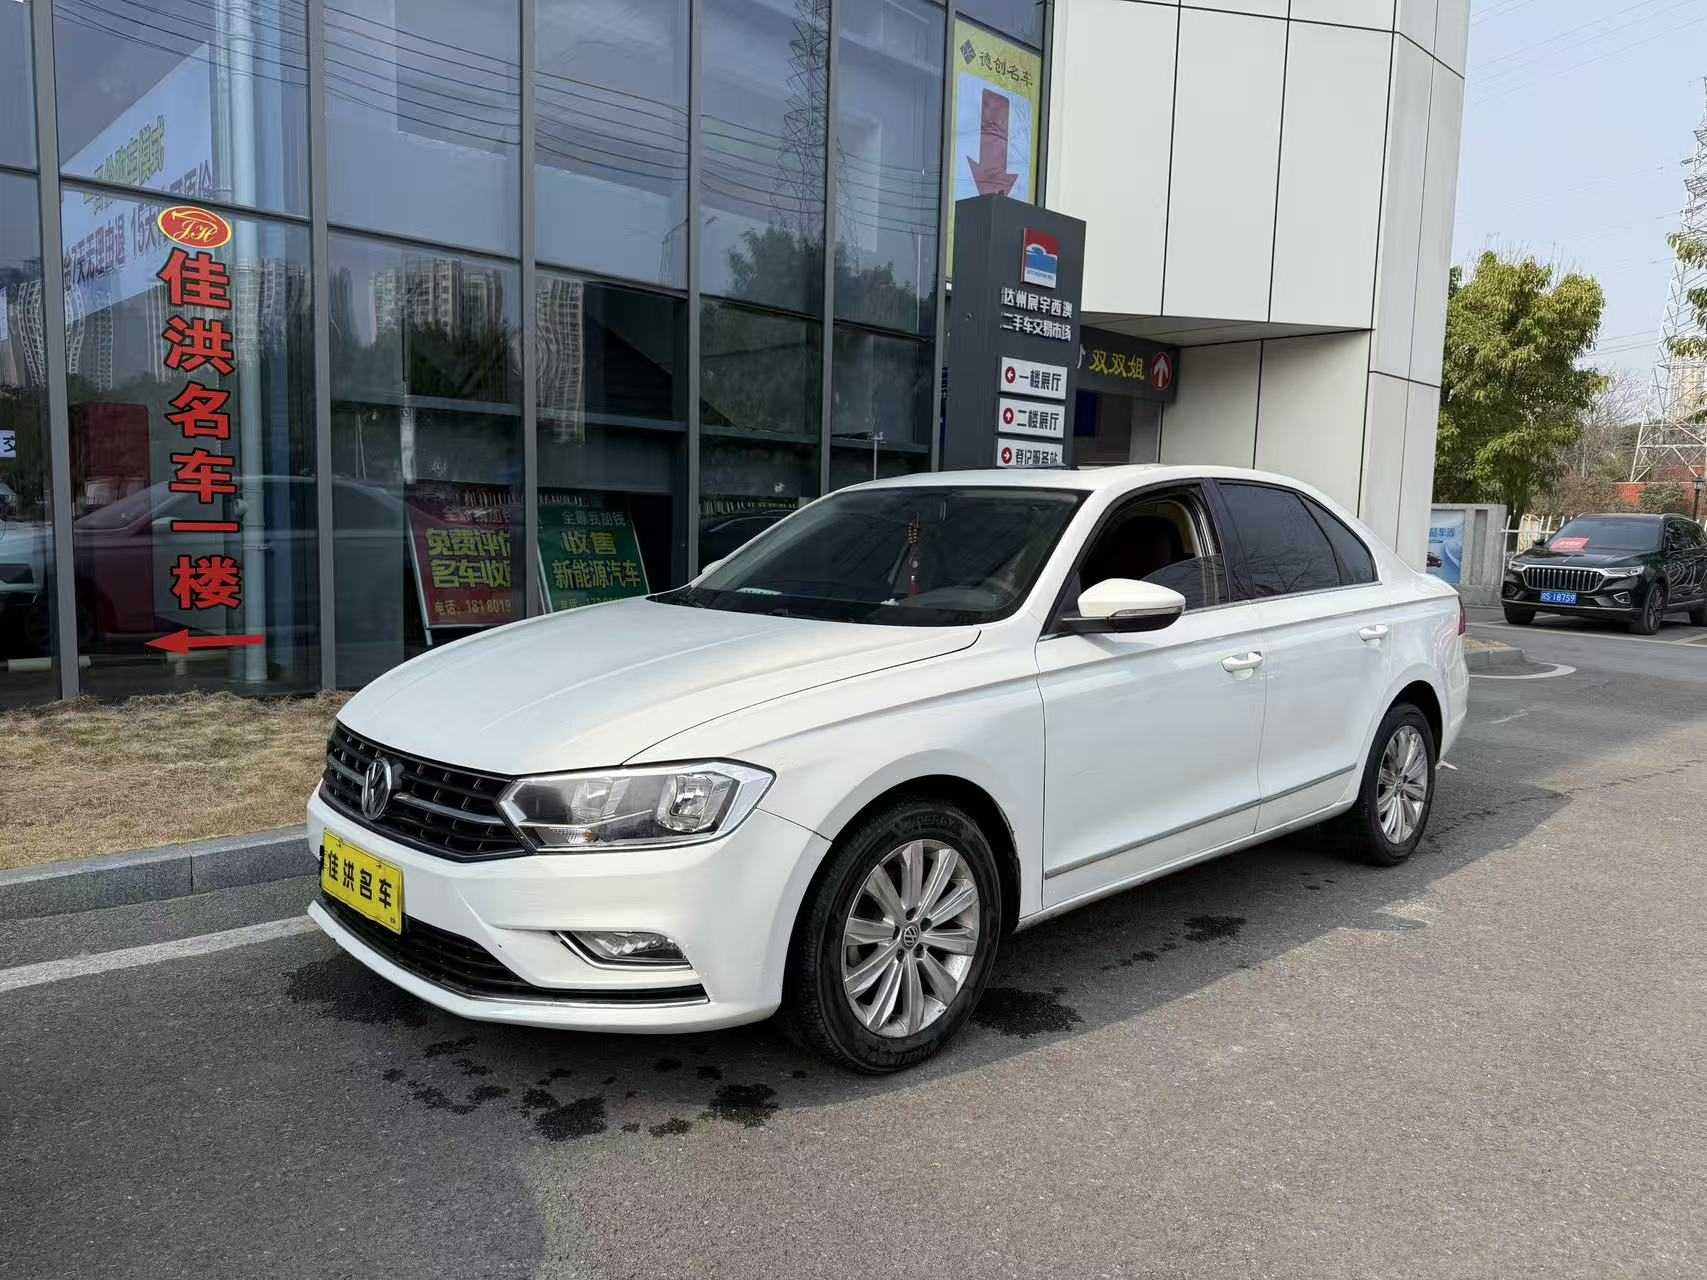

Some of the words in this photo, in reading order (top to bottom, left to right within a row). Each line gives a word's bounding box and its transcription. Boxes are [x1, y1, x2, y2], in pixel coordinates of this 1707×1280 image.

[1000, 312, 1071, 341] 二手车交易市场
[1019, 369, 1062, 392] 一楼展厅
[157, 247, 242, 610] 佳洪名车一楼
[1017, 410, 1059, 431] 二楼展厅
[551, 559, 641, 589] 新能源汽车
[327, 850, 392, 909] 佳洪名车
